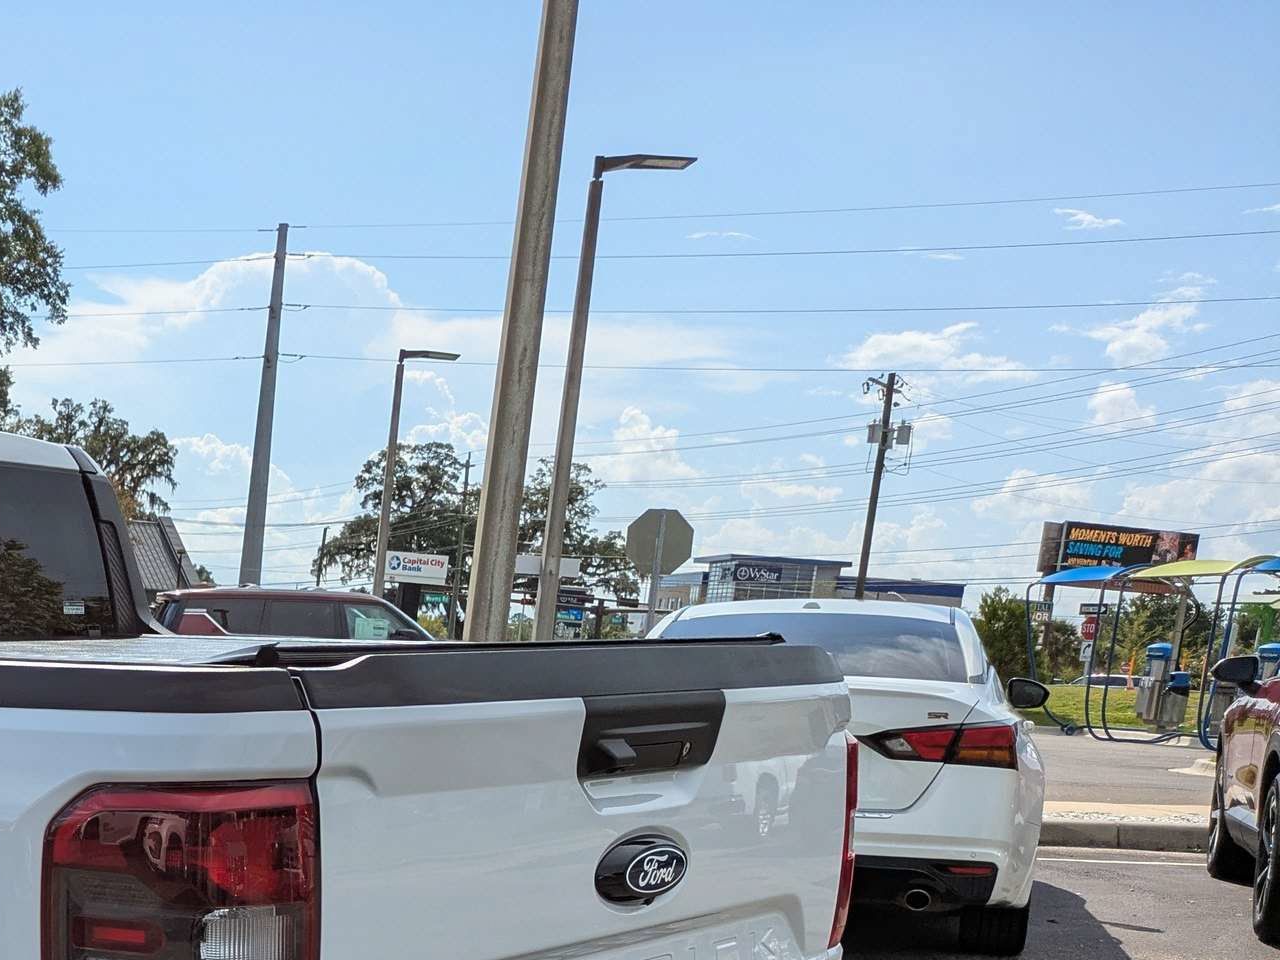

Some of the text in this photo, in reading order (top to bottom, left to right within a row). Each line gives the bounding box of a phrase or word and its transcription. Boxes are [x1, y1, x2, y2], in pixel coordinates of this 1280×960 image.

[1069, 528, 1153, 547] MOMENTS WORTH
[1066, 541, 1125, 559] SAVING FOR
[401, 564, 422, 573] Bank
[402, 557, 445, 568] Capital City
[750, 567, 779, 581] VyStar
[1082, 623, 1096, 633] STO
[927, 711, 949, 720] SR
[639, 854, 677, 887] Ford
